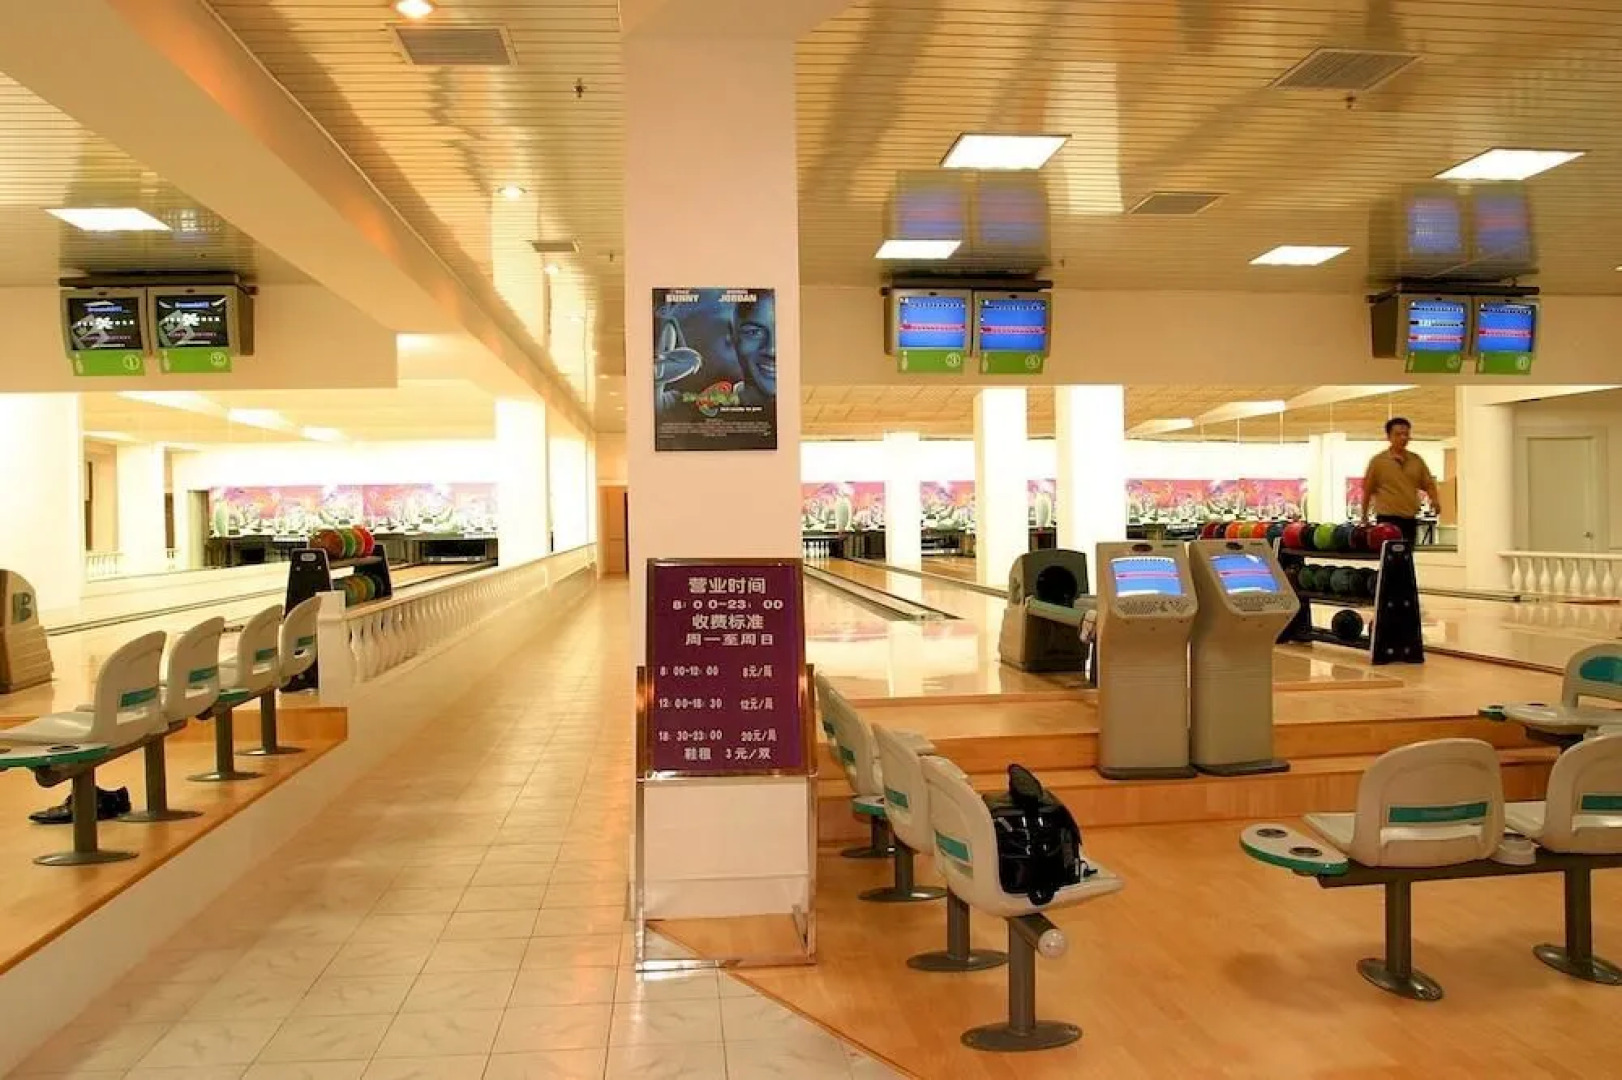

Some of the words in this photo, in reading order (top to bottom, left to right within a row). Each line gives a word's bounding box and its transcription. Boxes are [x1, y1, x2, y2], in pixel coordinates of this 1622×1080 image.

[688, 577, 766, 594] 营业时间
[692, 614, 764, 630] 收费标准
[685, 633, 773, 646] 周一至周日
